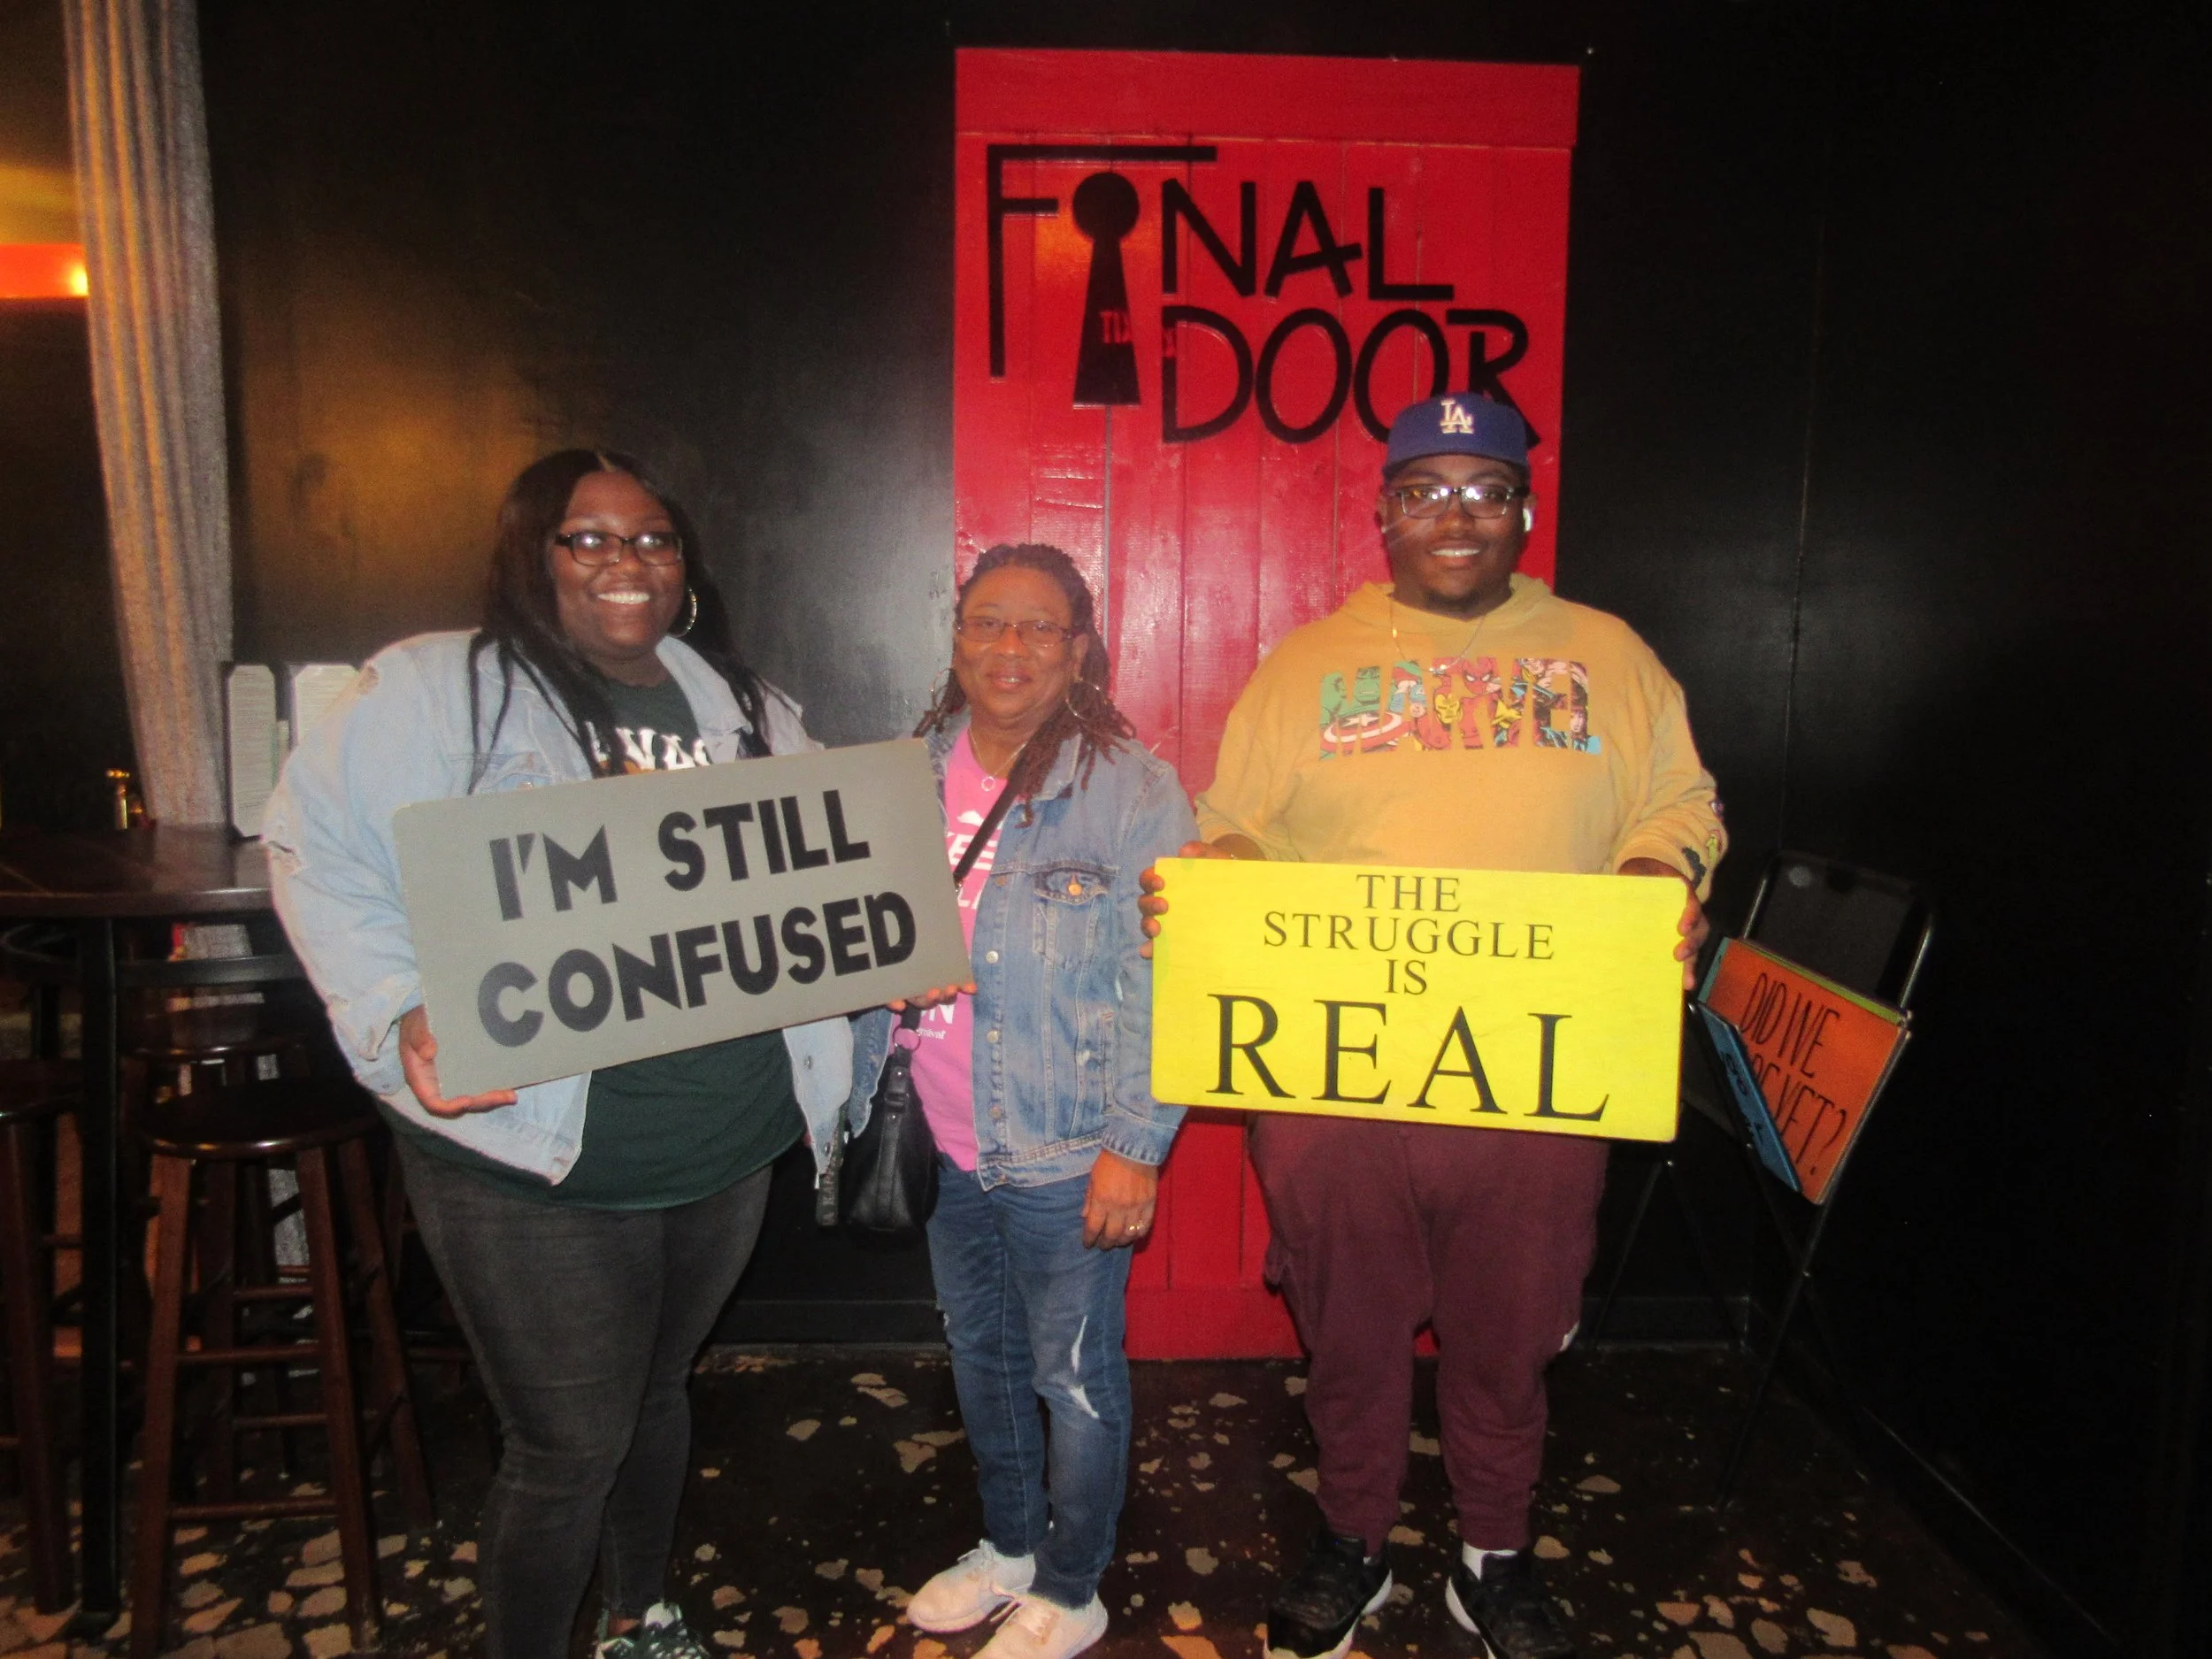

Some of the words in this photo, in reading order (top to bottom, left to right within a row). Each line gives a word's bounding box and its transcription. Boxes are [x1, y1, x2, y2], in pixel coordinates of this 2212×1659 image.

[1161, 306, 1540, 446] DOOR
[1440, 398, 1474, 434] LA
[1319, 657, 1601, 761] MARVEL
[489, 826, 618, 921] I'M
[657, 789, 870, 891] STILL
[1356, 874, 1461, 913] THE
[477, 891, 916, 1048] CONFUSED
[1263, 911, 1555, 960] STRUGGLE
[1385, 959, 1428, 995] IS
[1740, 972, 1787, 1044] DID
[1205, 994, 1609, 1122] REAL
